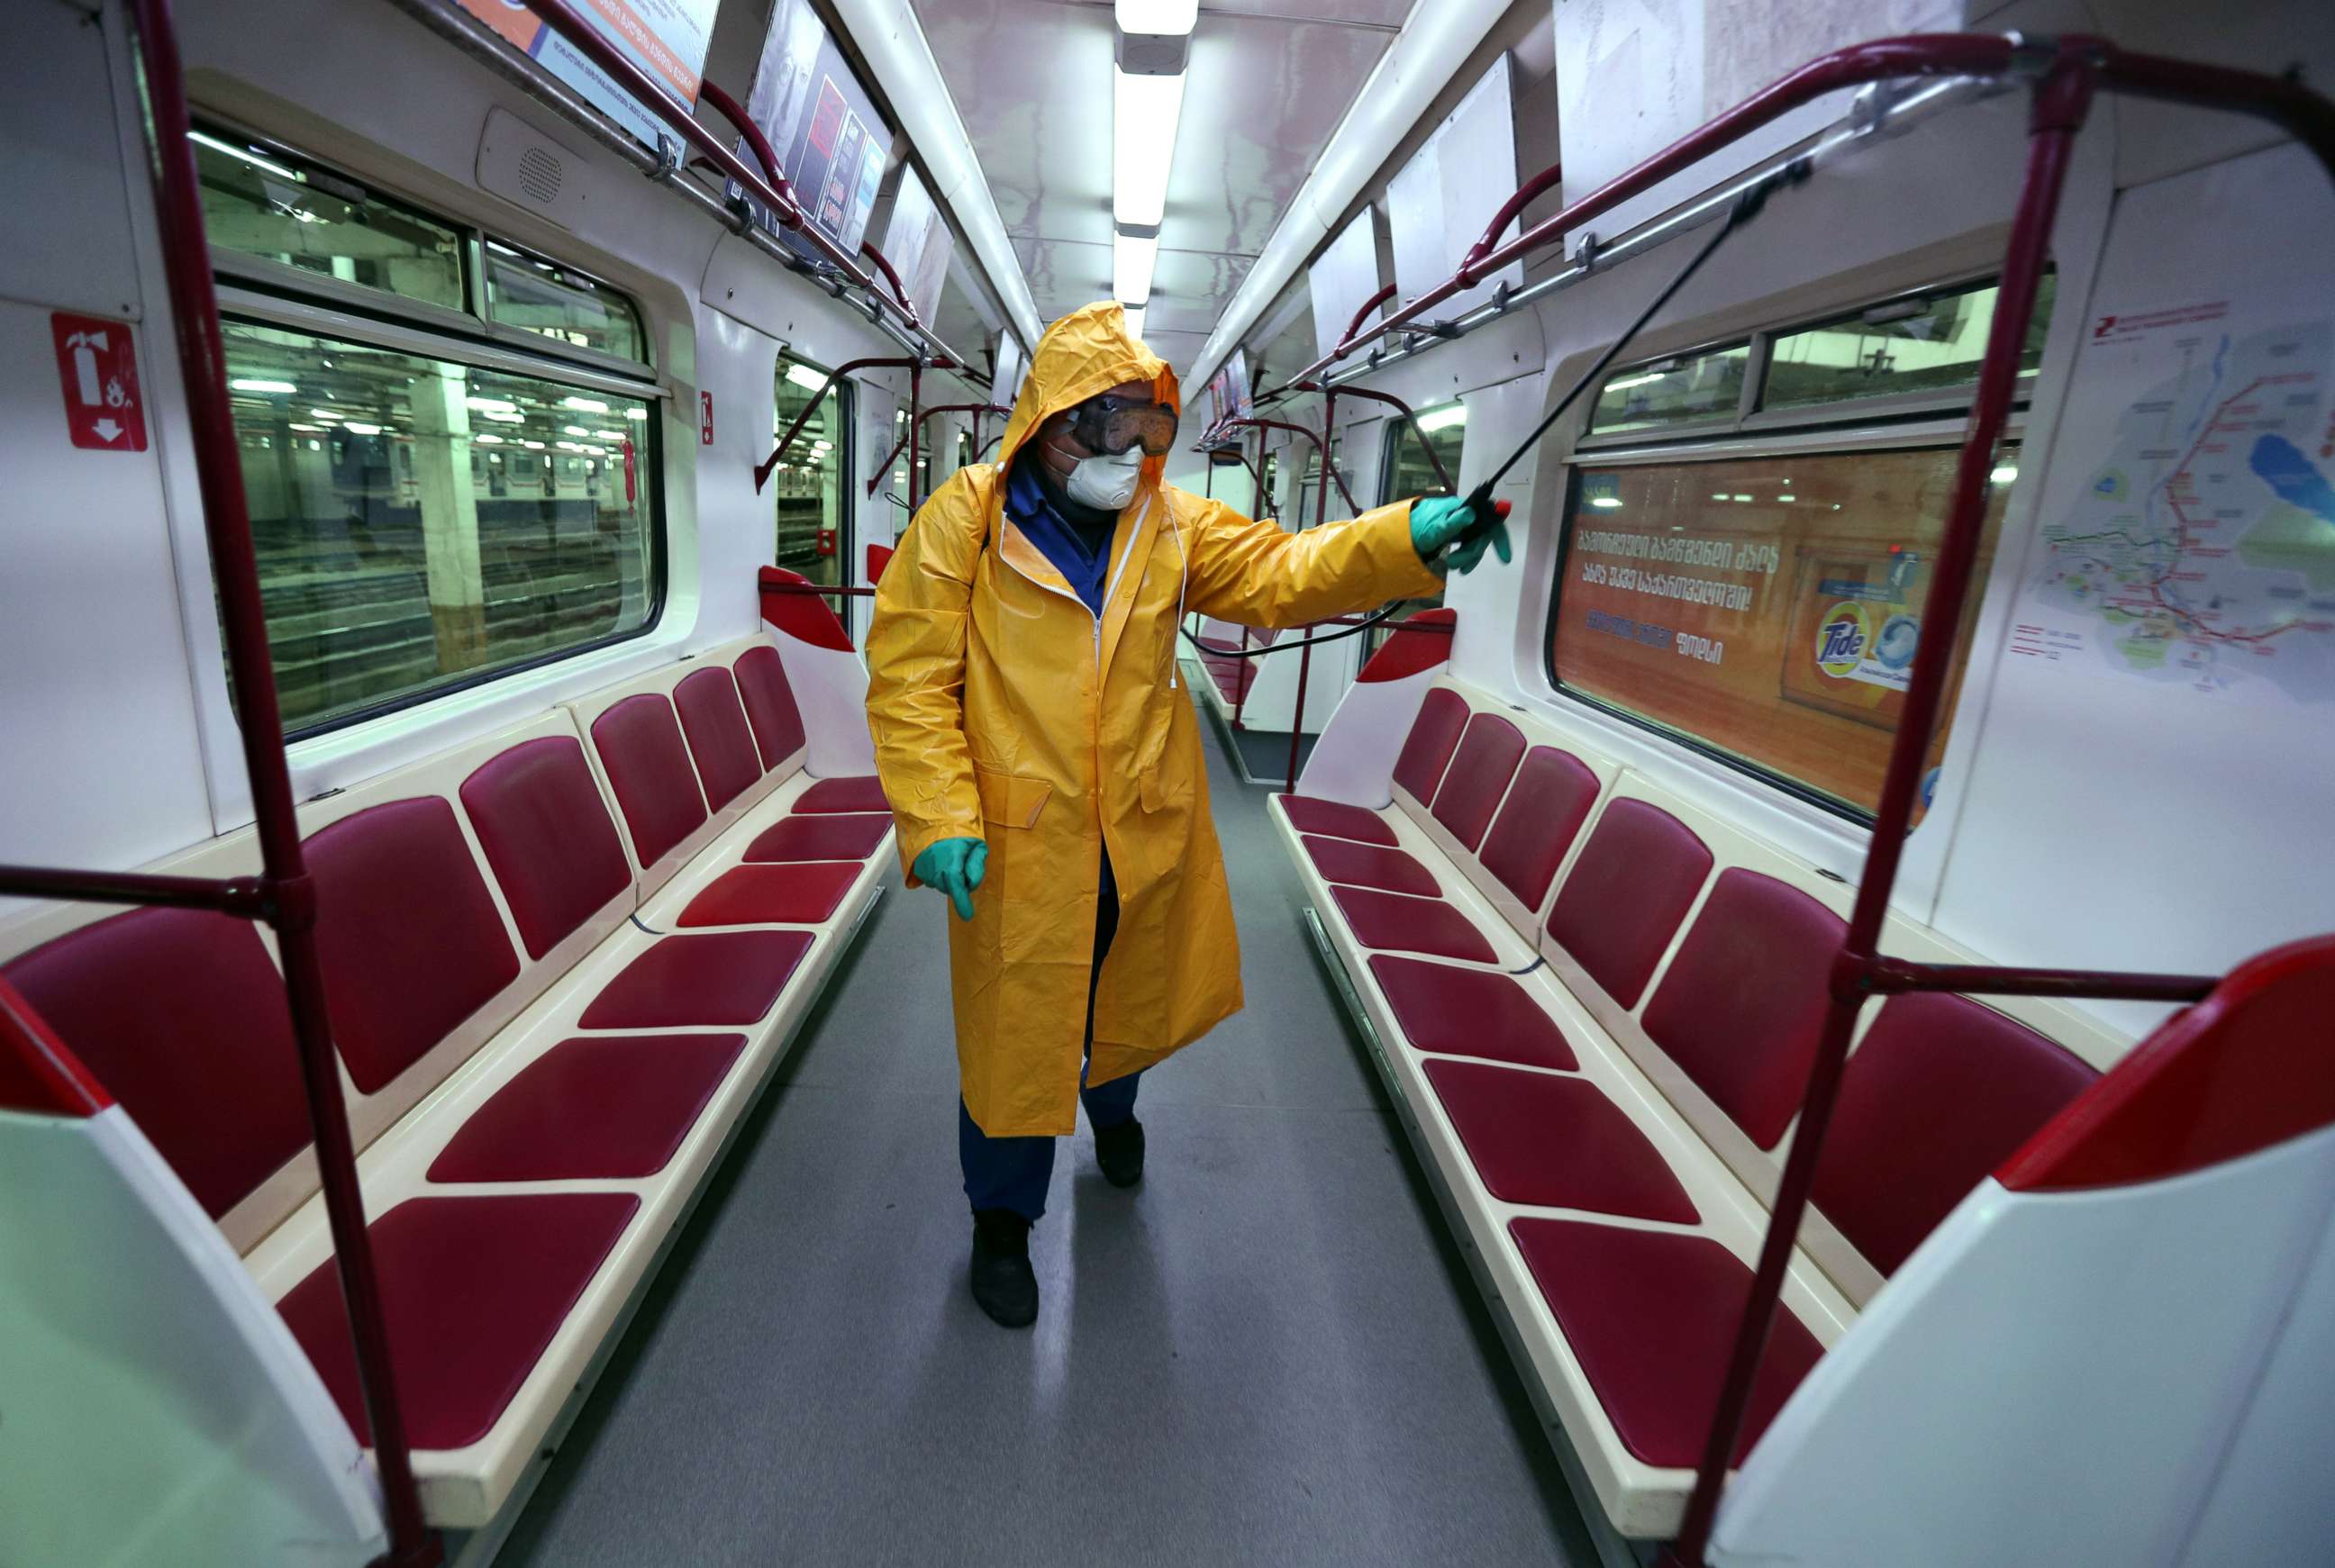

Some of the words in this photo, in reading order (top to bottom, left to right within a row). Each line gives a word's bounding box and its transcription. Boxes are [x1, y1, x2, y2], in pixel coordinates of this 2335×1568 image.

[1651, 536, 1732, 569] გამწმენდი
[1735, 543, 1779, 574] ძალა
[1582, 562, 1606, 585] ახლა
[1609, 566, 1637, 591] უკვე
[1638, 571, 1753, 612] საქართველოში!
[1818, 622, 1866, 663] Tide
